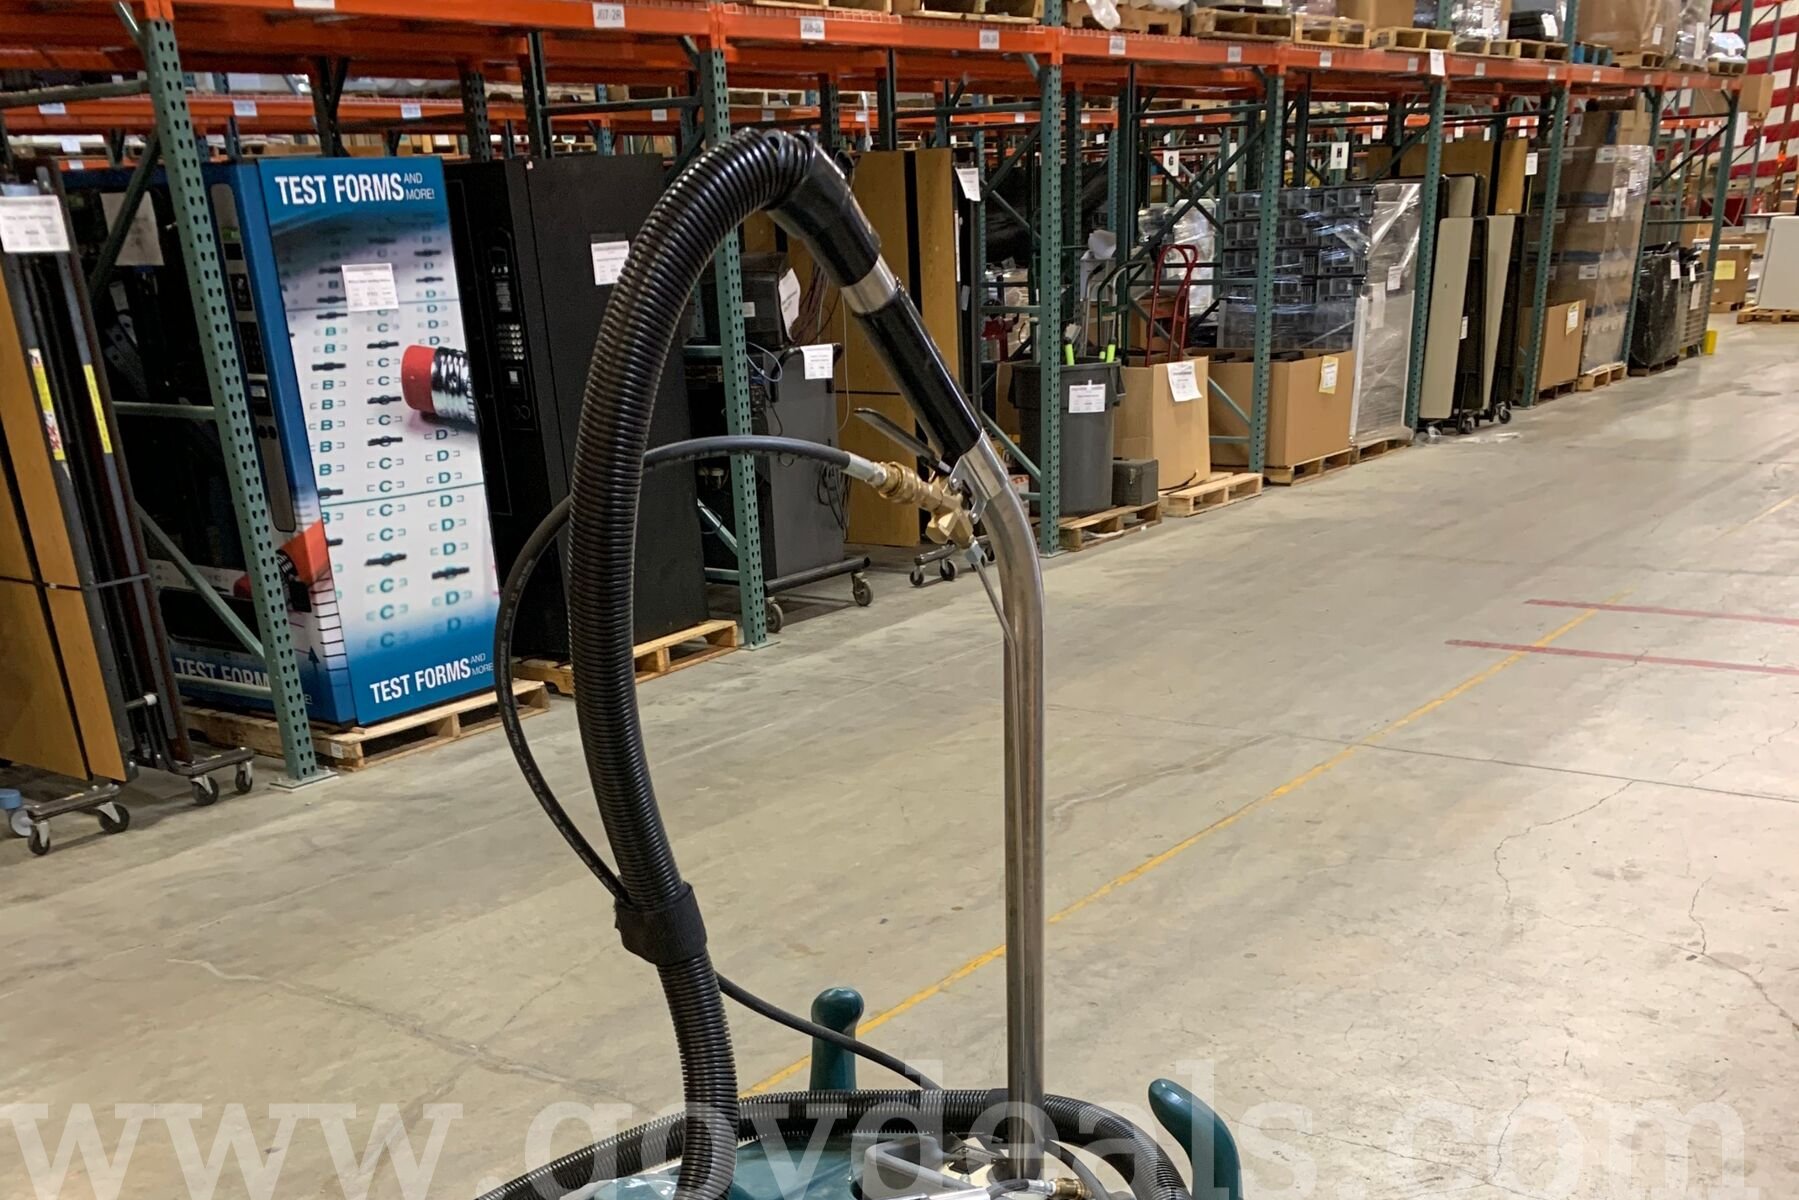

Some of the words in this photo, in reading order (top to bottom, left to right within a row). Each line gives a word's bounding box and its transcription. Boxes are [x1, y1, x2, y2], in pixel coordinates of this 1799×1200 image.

[404, 173, 423, 184] AND
[274, 174, 327, 205] TEST
[332, 172, 404, 203] FORMS
[406, 188, 435, 200] MORE!
[470, 653, 486, 664] AND
[370, 674, 410, 704] TEST
[414, 658, 471, 692] FORMS
